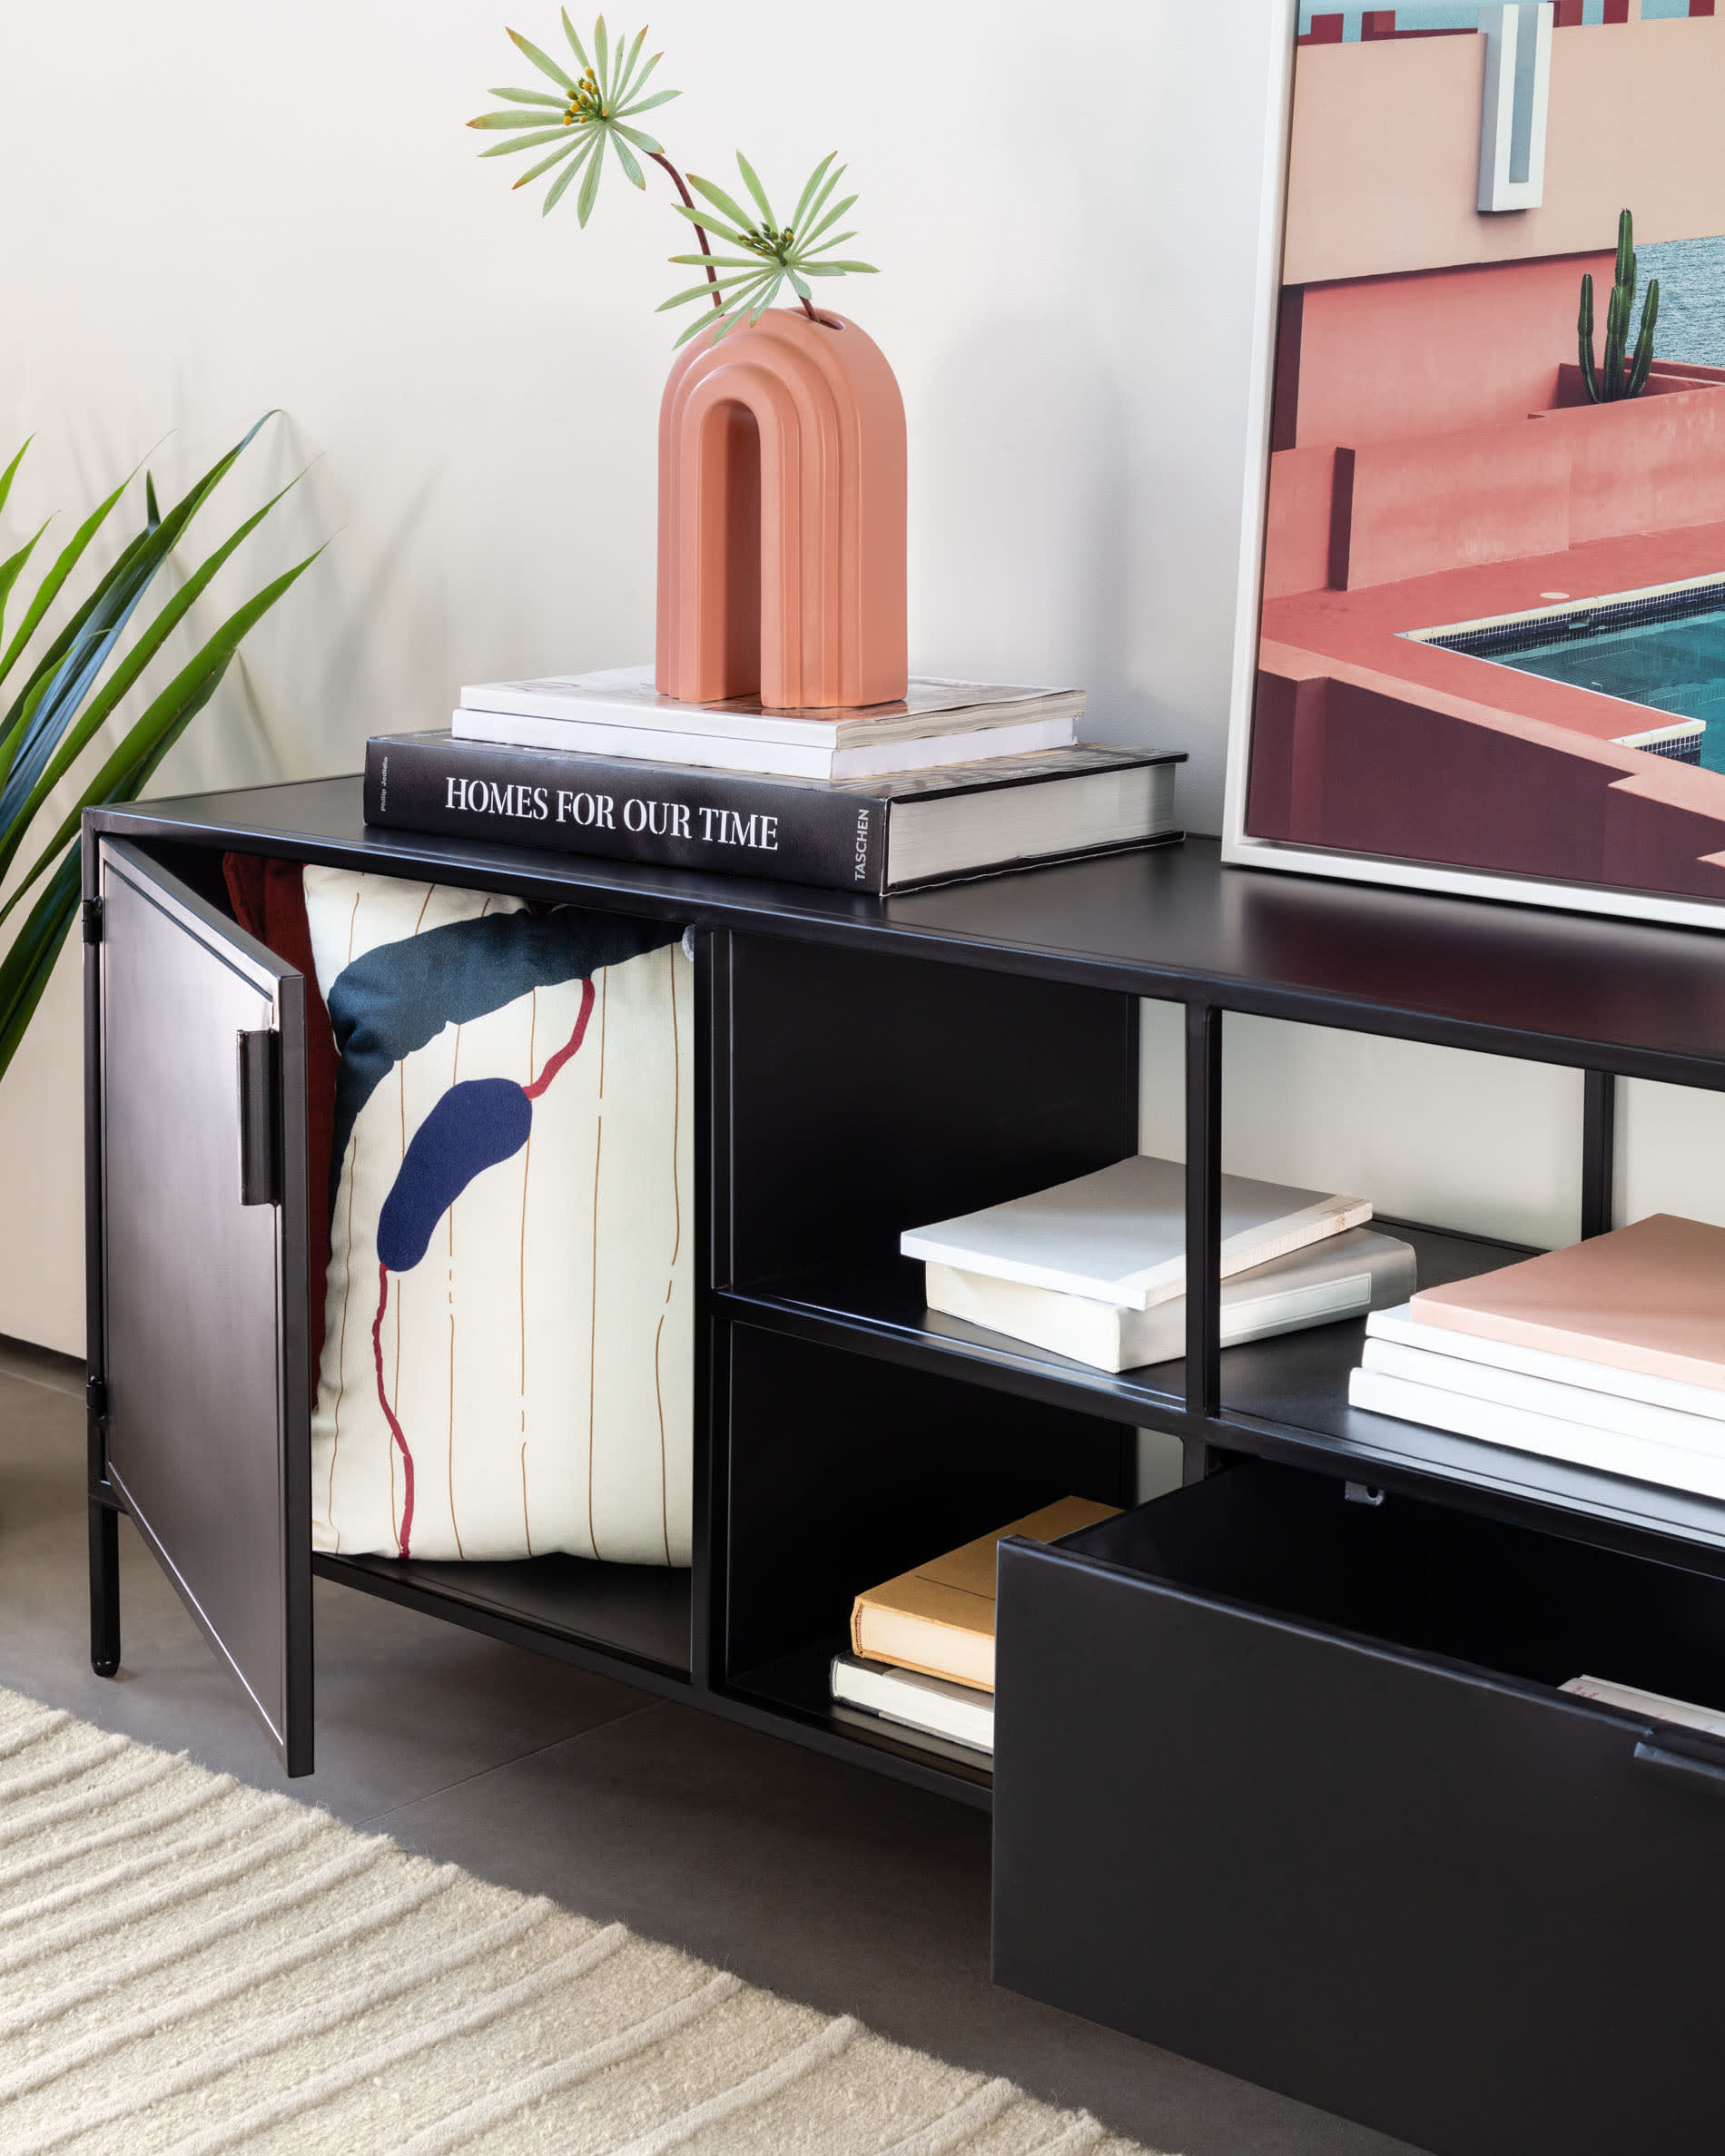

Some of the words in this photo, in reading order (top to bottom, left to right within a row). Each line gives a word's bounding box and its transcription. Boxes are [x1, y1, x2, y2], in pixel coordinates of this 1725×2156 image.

[380, 756, 389, 787] Jodidio
[380, 788, 388, 812] Philip
[445, 776, 548, 821] HOMES
[556, 790, 617, 830] FOR
[623, 799, 693, 840] OUR
[698, 806, 778, 851] TIME
[854, 808, 870, 881] TASCHEN
